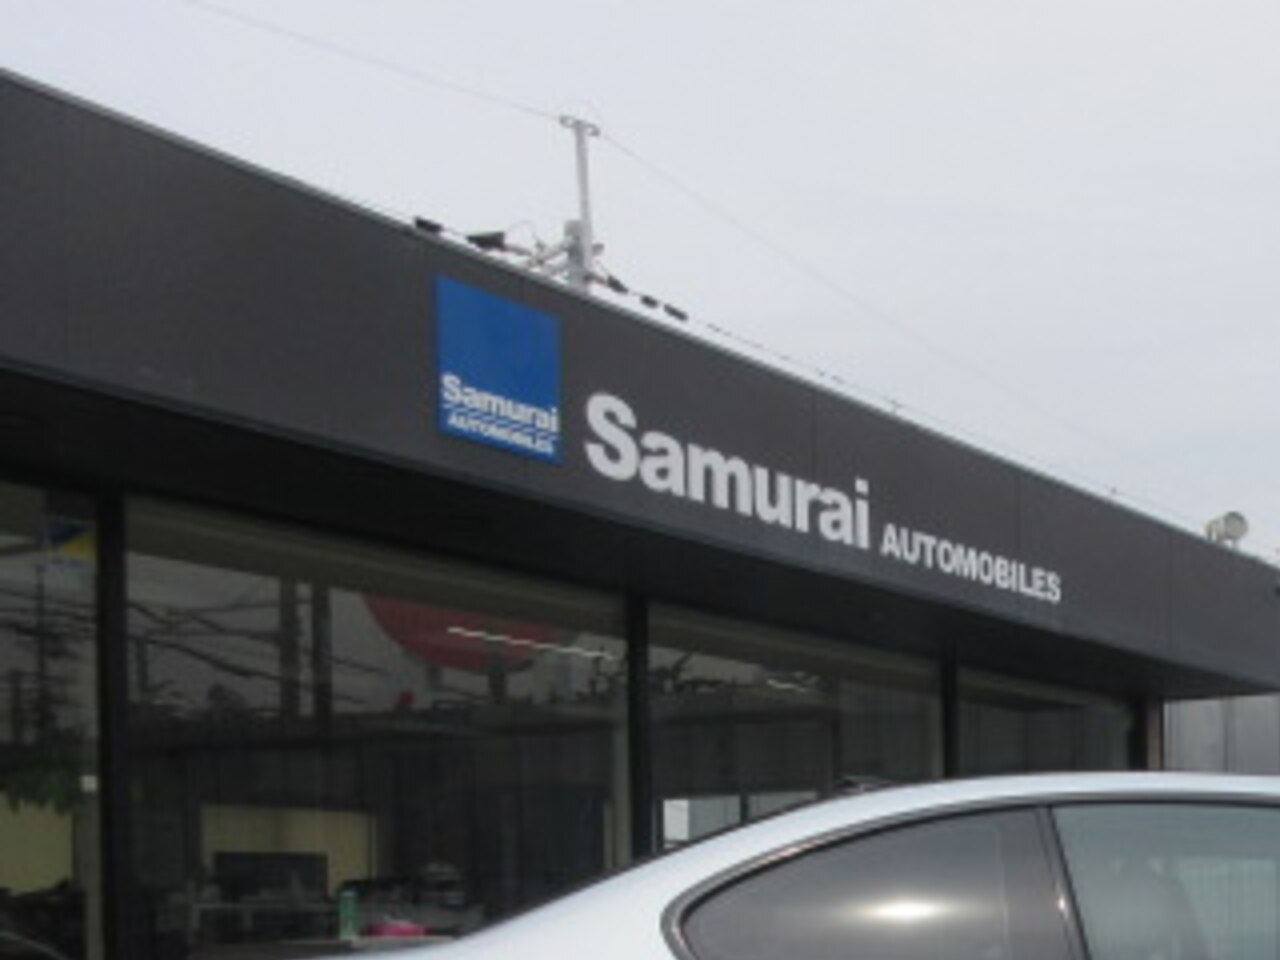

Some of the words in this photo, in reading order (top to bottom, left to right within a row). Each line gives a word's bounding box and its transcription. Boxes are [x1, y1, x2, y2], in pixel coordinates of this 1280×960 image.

[442, 373, 558, 432] Samurai
[585, 392, 870, 549] Samurai
[880, 523, 1062, 603] AUTOMOBILES
